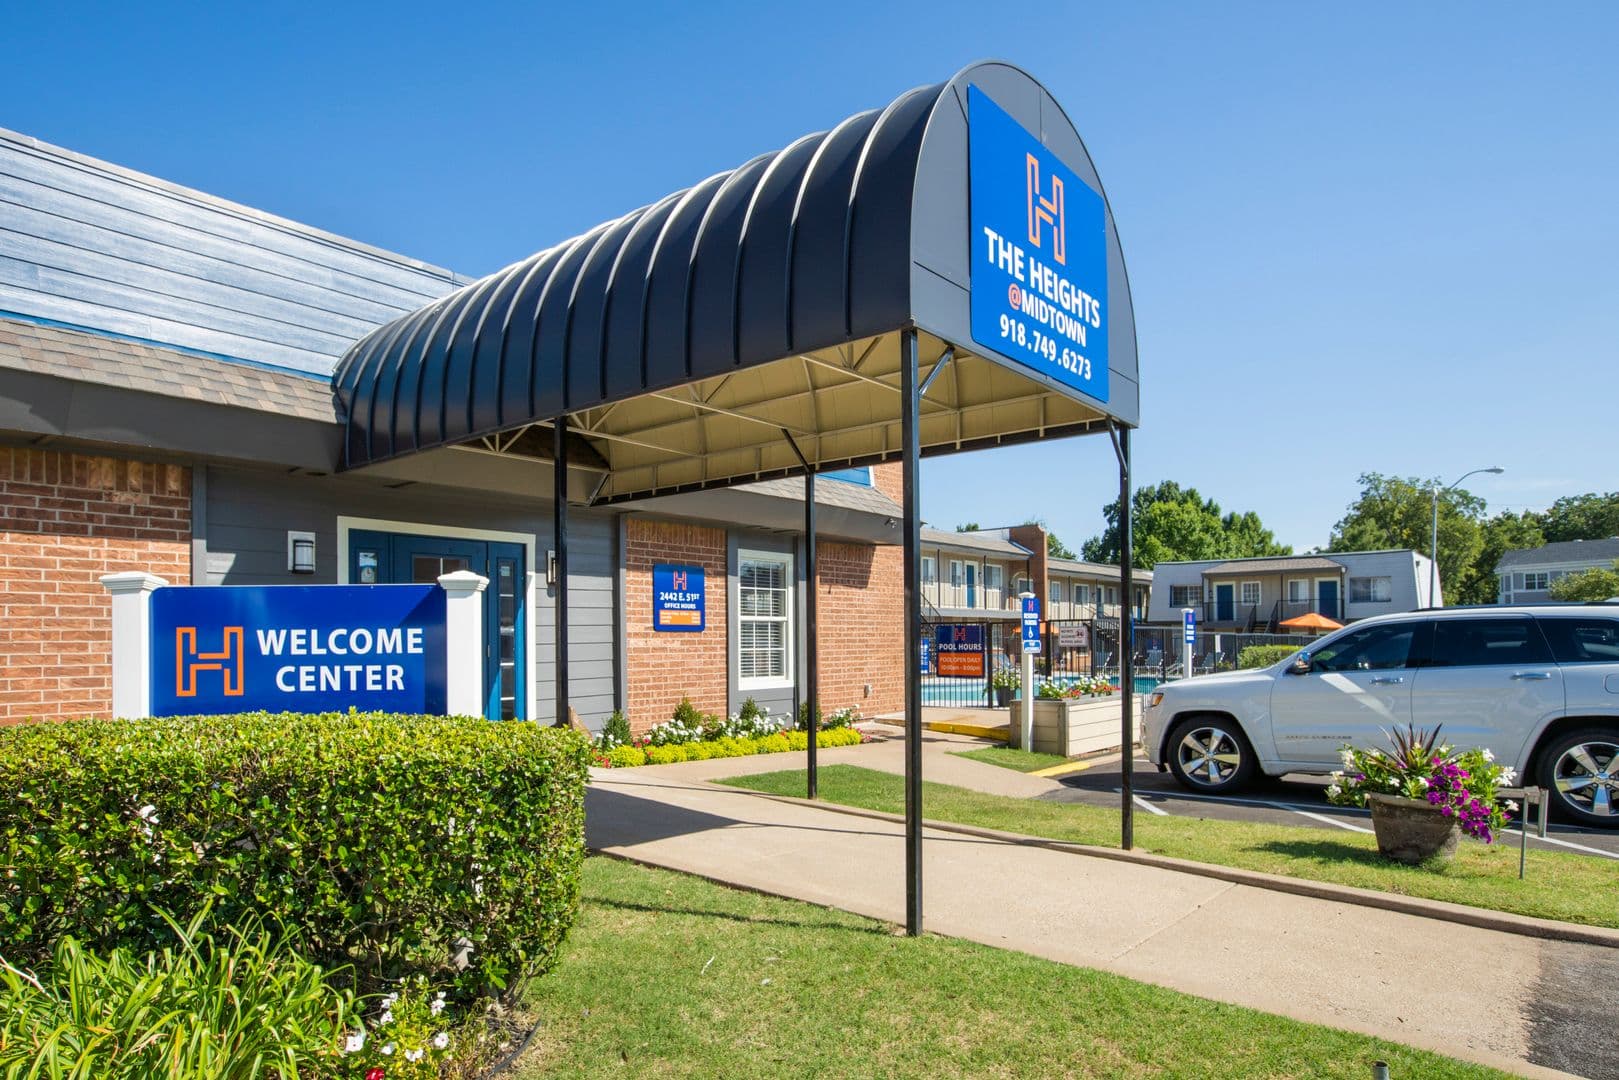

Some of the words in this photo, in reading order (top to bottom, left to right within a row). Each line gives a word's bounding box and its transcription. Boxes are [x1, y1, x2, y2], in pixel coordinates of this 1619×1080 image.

[984, 226, 1025, 282] THE
[1029, 256, 1101, 329] HEIGHTS
[1008, 283, 1087, 348] @MIDTOWN
[1000, 313, 1092, 381] 918.749.6273
[659, 592, 678, 601] 2442
[678, 593, 685, 601] E.
[176, 626, 244, 697] H
[256, 628, 423, 656] WELCOME
[938, 643, 957, 651] POOL
[958, 643, 983, 651] HOURS
[275, 664, 405, 692] CENTER
